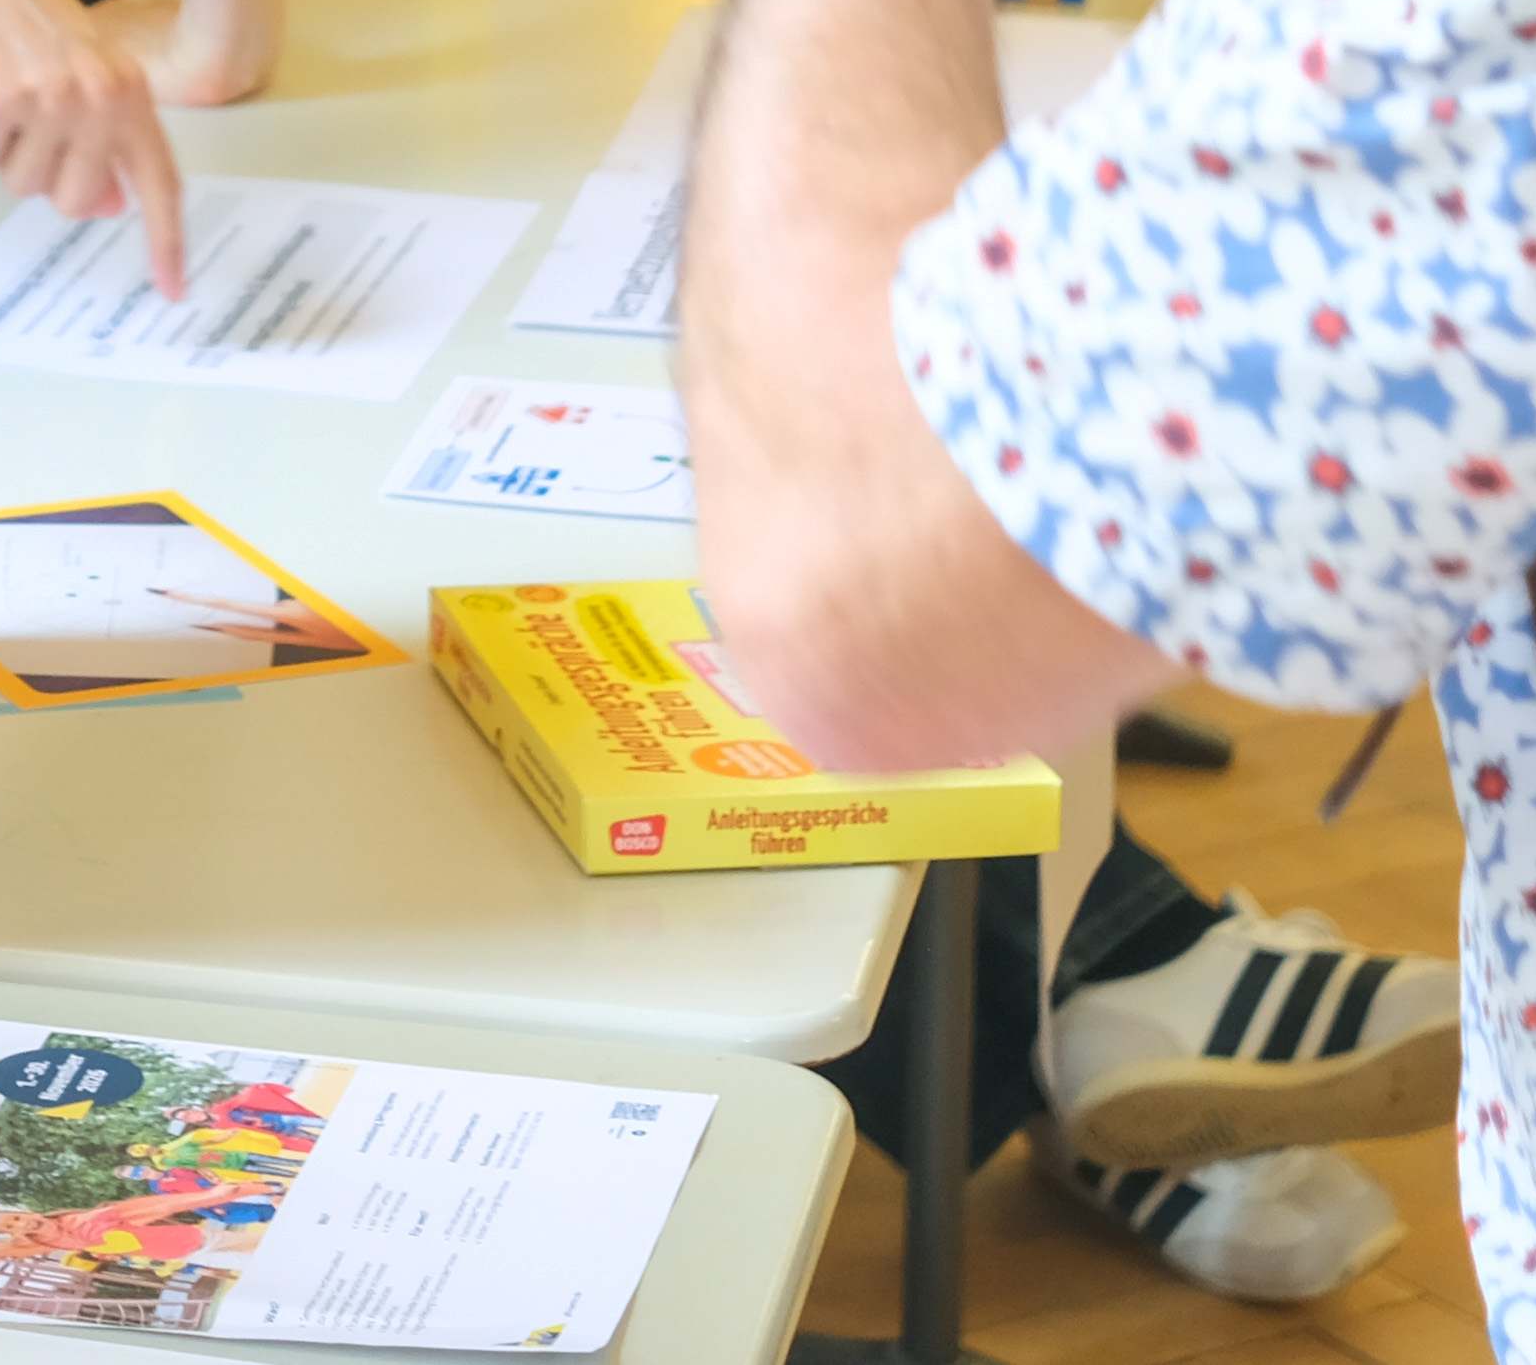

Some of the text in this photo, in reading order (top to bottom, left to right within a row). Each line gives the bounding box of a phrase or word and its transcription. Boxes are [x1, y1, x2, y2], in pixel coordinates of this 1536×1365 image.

[707, 801, 891, 831] Anleitungsgespräche
[750, 831, 807, 855] führen
[37, 1053, 85, 1101] November
